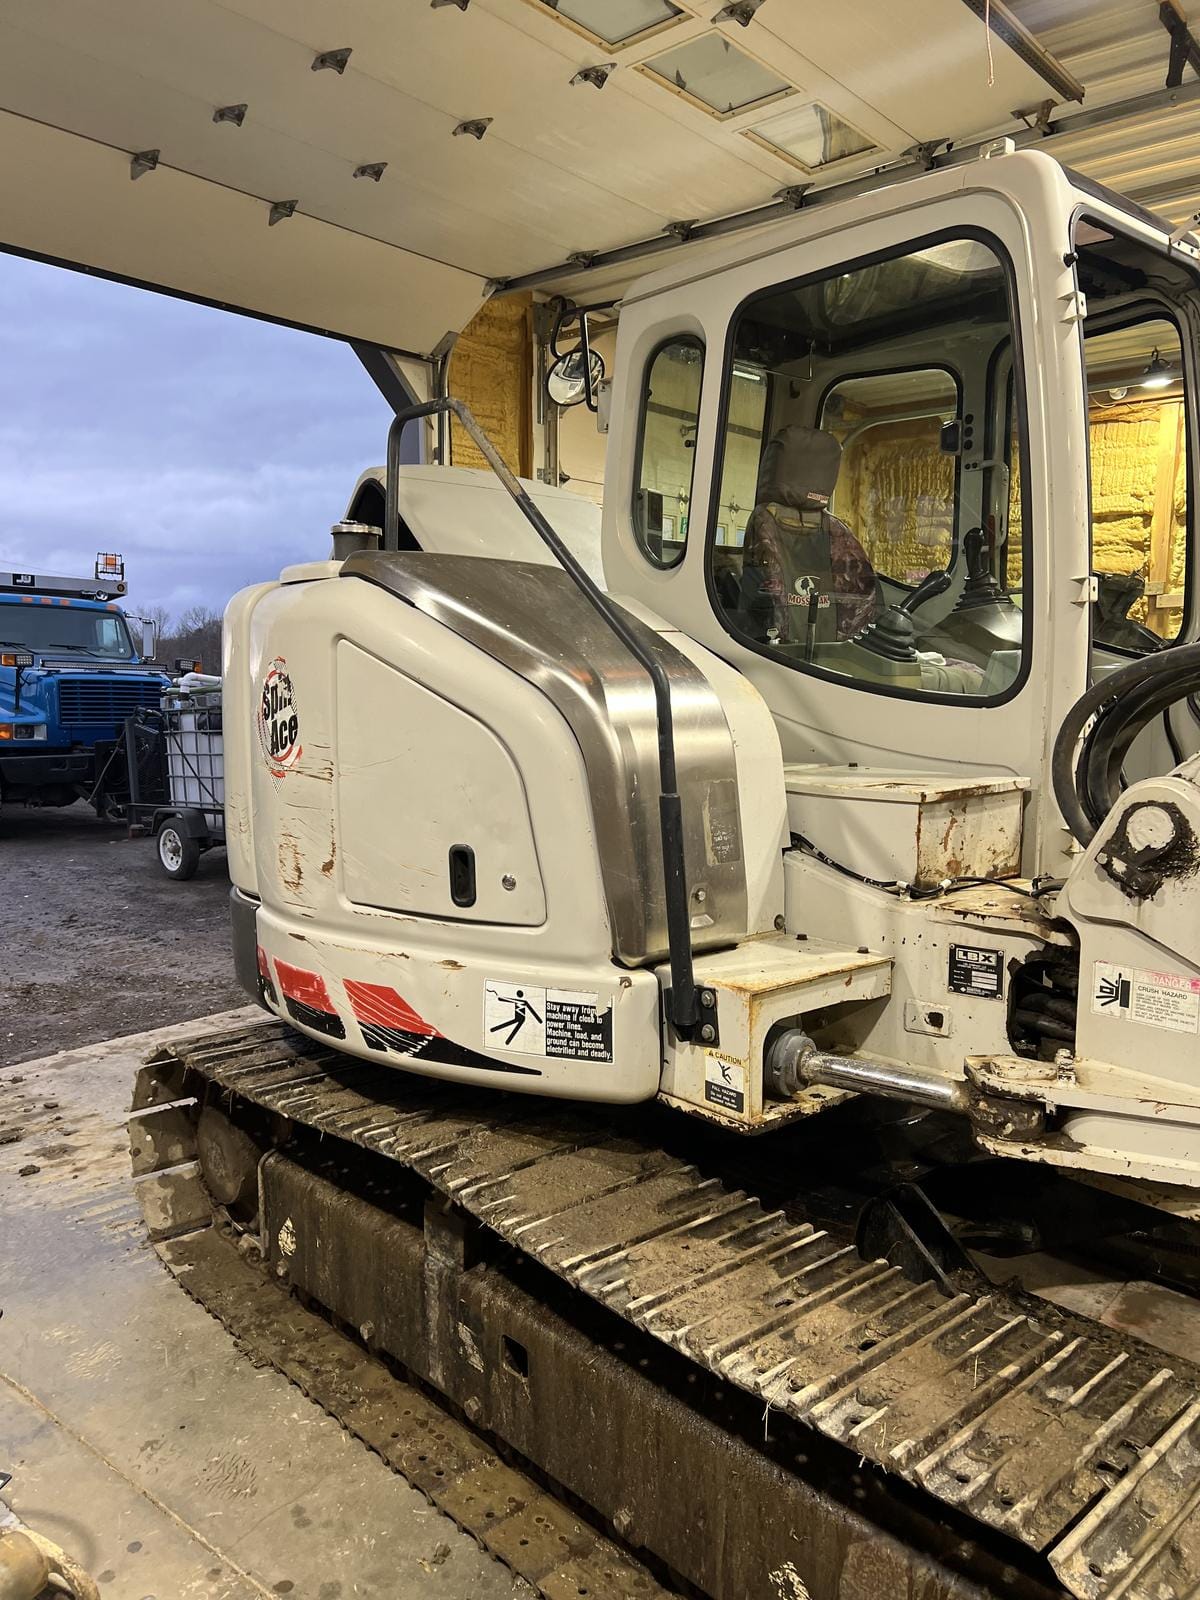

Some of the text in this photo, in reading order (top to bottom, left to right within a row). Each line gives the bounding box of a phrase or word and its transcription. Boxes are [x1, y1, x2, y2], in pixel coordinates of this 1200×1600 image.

[270, 713, 299, 757] Ace
[957, 949, 995, 965] LBX
[1137, 985, 1188, 1000] CRUSH HAZARD
[546, 1002, 560, 1012] Stay
[562, 1006, 580, 1015] away
[546, 1012, 571, 1021] machine
[596, 1016, 603, 1024] to
[546, 1021, 583, 1030] power lines.
[574, 1031, 589, 1040] load,
[590, 1033, 602, 1041] and
[546, 1038, 567, 1046] ground
[581, 1041, 604, 1050] become
[546, 1046, 576, 1055] electrified
[590, 1051, 613, 1059] deadly.
[715, 1052, 742, 1065] CAUTION
